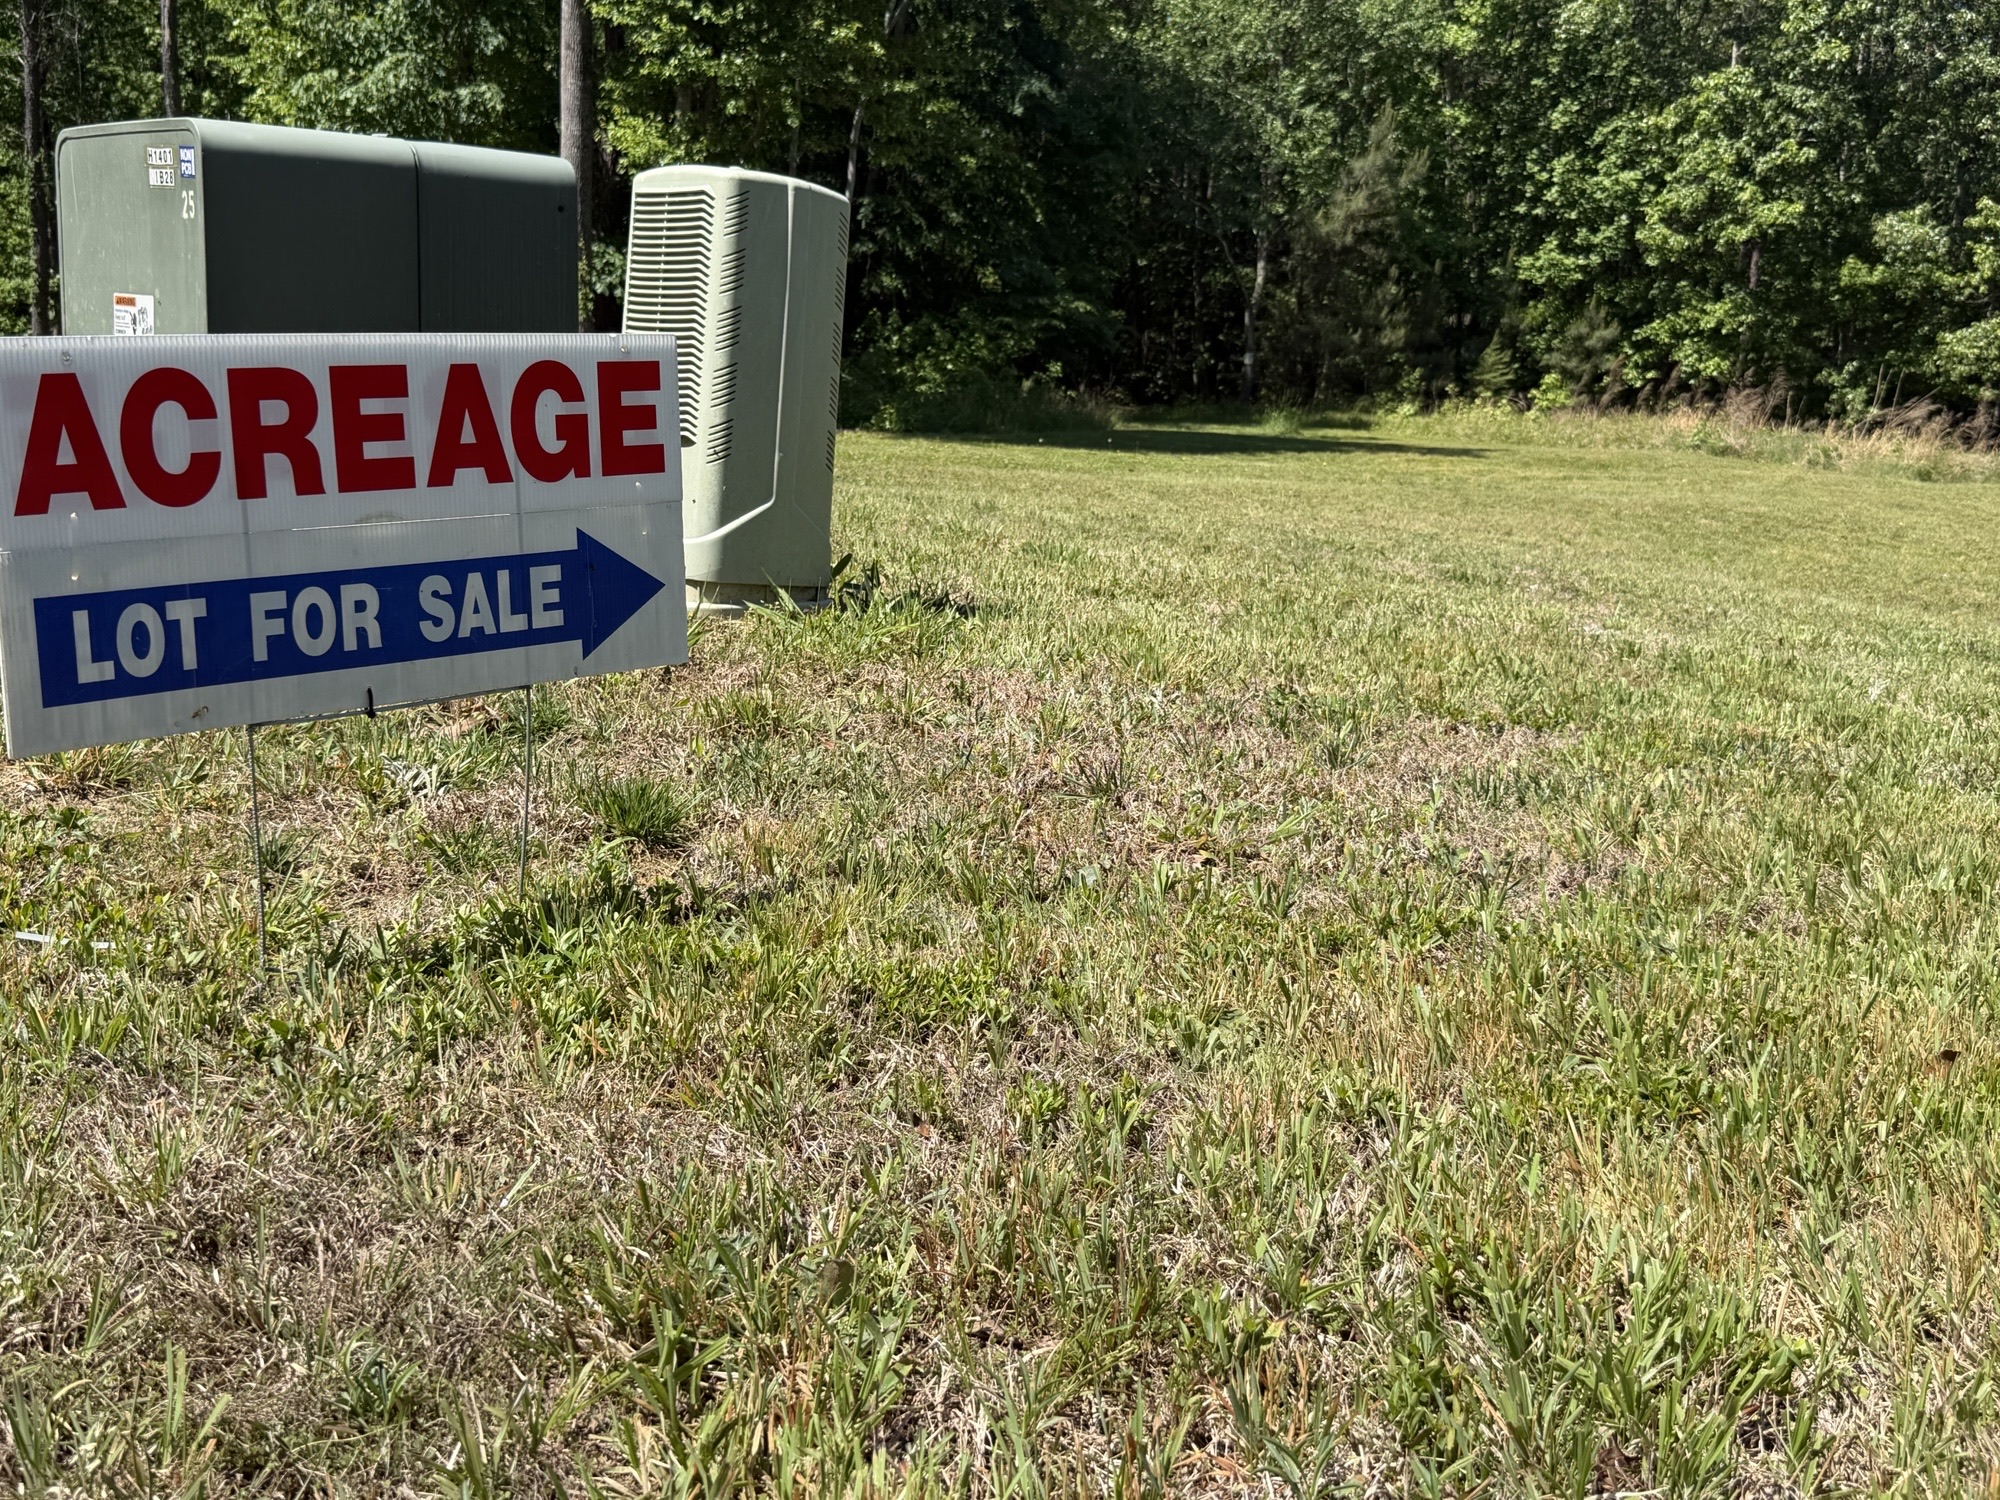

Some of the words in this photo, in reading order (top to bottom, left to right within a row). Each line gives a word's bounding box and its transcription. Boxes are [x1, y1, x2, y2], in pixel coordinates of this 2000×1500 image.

[147, 149, 172, 163] H1401
[181, 190, 195, 219] 25
[14, 359, 666, 516] ACREAGE
[72, 597, 207, 684] LOT
[250, 583, 382, 662] FOR
[419, 564, 564, 642] SALE
